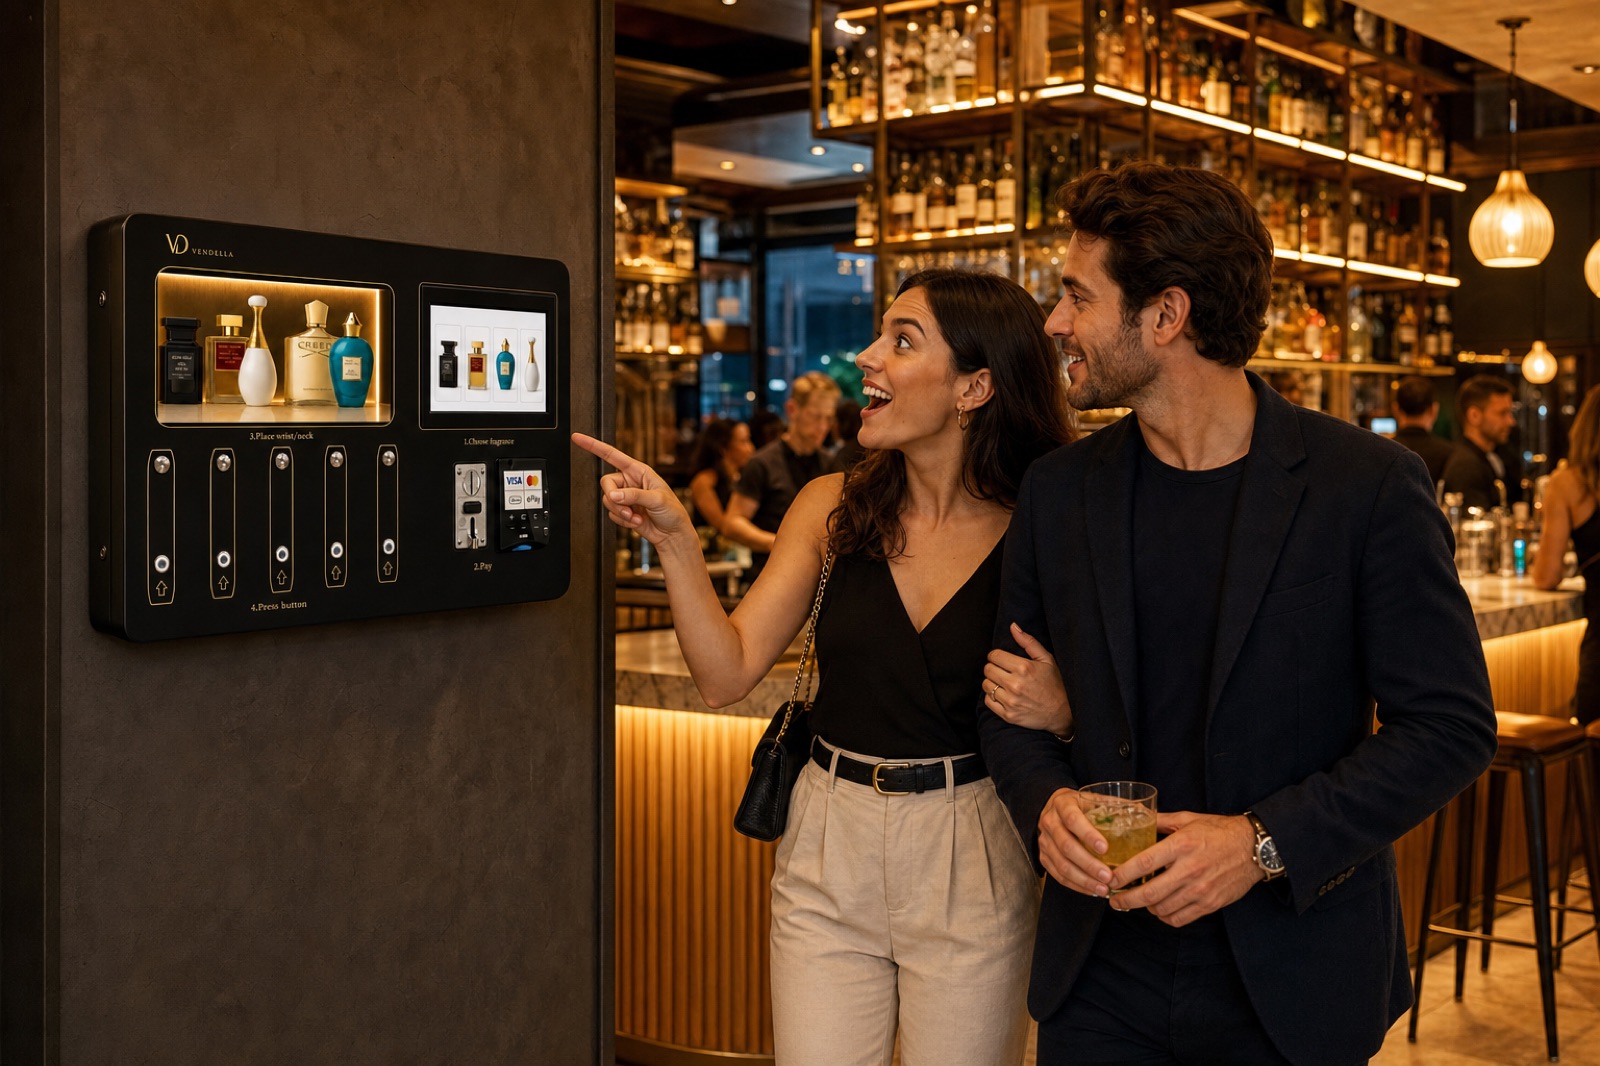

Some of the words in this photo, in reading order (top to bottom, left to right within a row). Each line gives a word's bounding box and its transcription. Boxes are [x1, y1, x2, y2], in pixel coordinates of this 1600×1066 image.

[192, 248, 234, 257] VENDELLA
[298, 341, 332, 350] CREED
[249, 432, 275, 440] 3.Place
[276, 431, 314, 440] wrist/neck
[506, 476, 522, 485] VISA
[473, 562, 492, 572] 2.Pay
[251, 603, 279, 611] 4.Press
[281, 601, 307, 609] button
